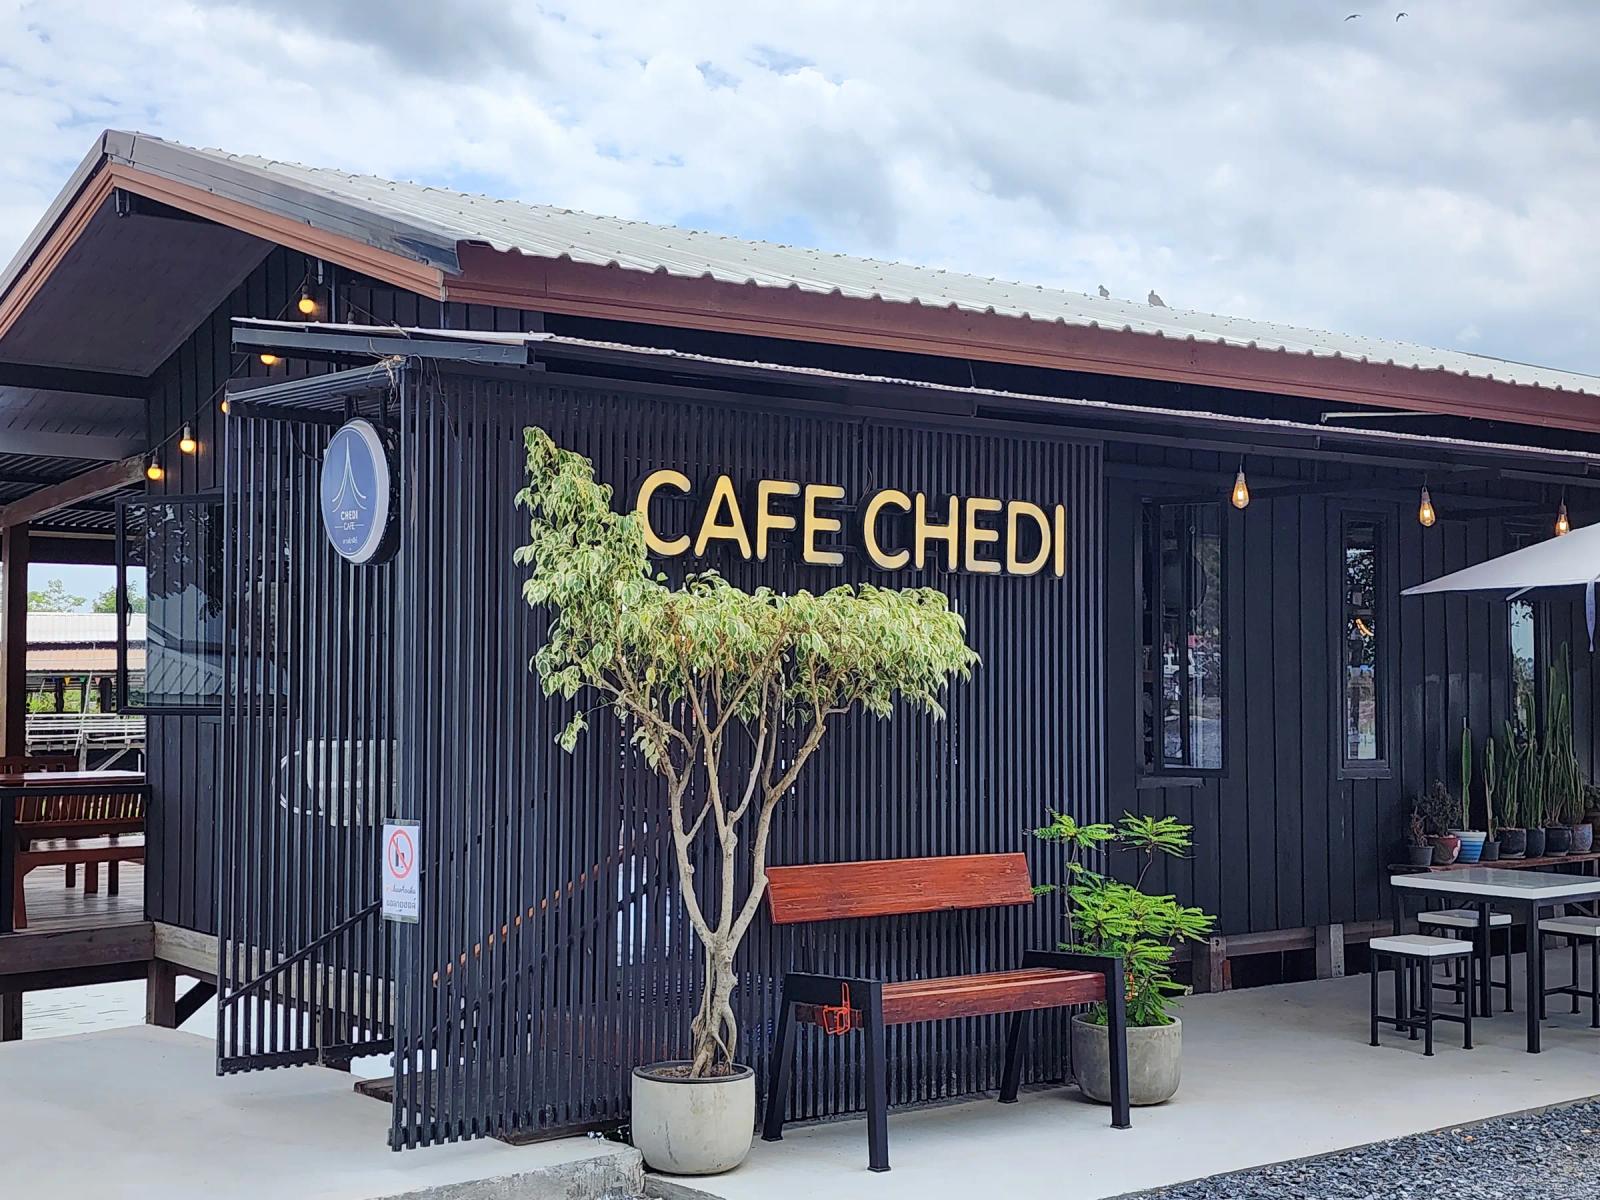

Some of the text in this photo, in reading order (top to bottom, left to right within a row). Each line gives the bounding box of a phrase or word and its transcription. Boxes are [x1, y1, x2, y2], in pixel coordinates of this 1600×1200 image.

[340, 509, 359, 521] CHEDI
[343, 521, 356, 531] CAFE
[636, 468, 1066, 578] CAFE CHEDI
